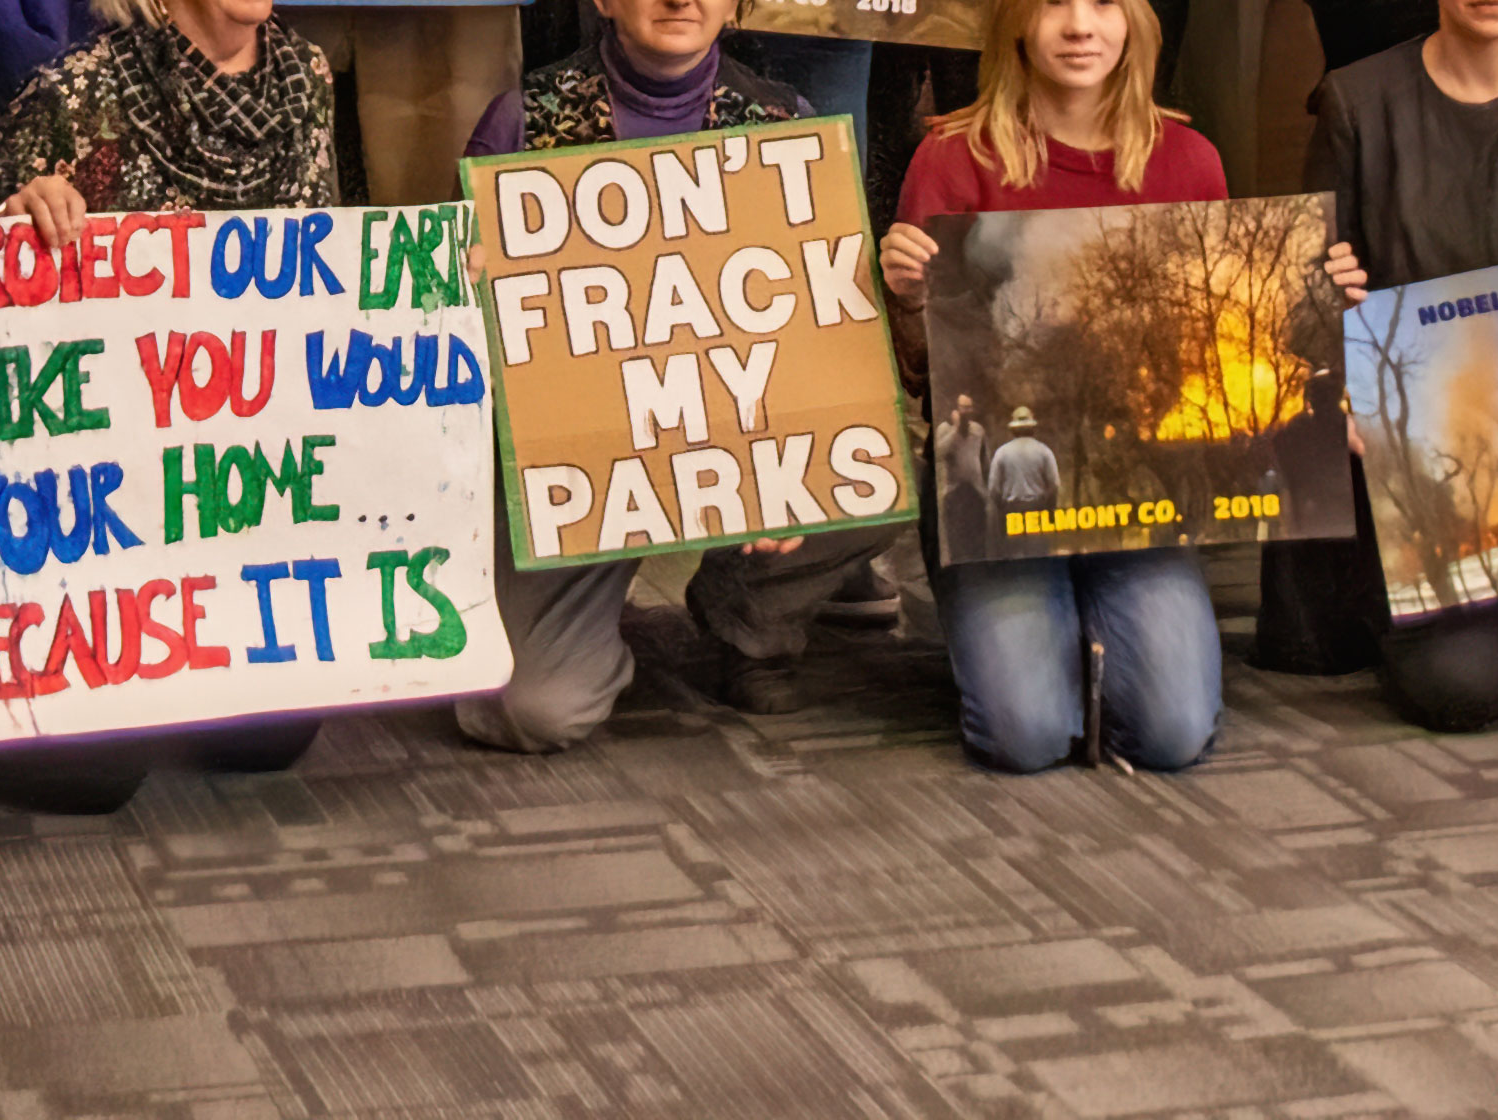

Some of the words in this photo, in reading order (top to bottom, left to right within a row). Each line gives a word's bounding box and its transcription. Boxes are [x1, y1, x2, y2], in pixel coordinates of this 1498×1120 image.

[496, 133, 823, 259] DON'T
[209, 212, 345, 299] OUR
[492, 233, 879, 368] FRACK
[135, 330, 276, 428] YOU
[305, 328, 486, 410] WOULD
[621, 341, 778, 452] MY
[522, 425, 898, 558] PARKS
[1006, 503, 1133, 536] BELMONT
[1138, 500, 1182, 523] CO.
[1214, 494, 1280, 519] 2018
[240, 557, 342, 663] IT
[366, 546, 468, 659] IS
